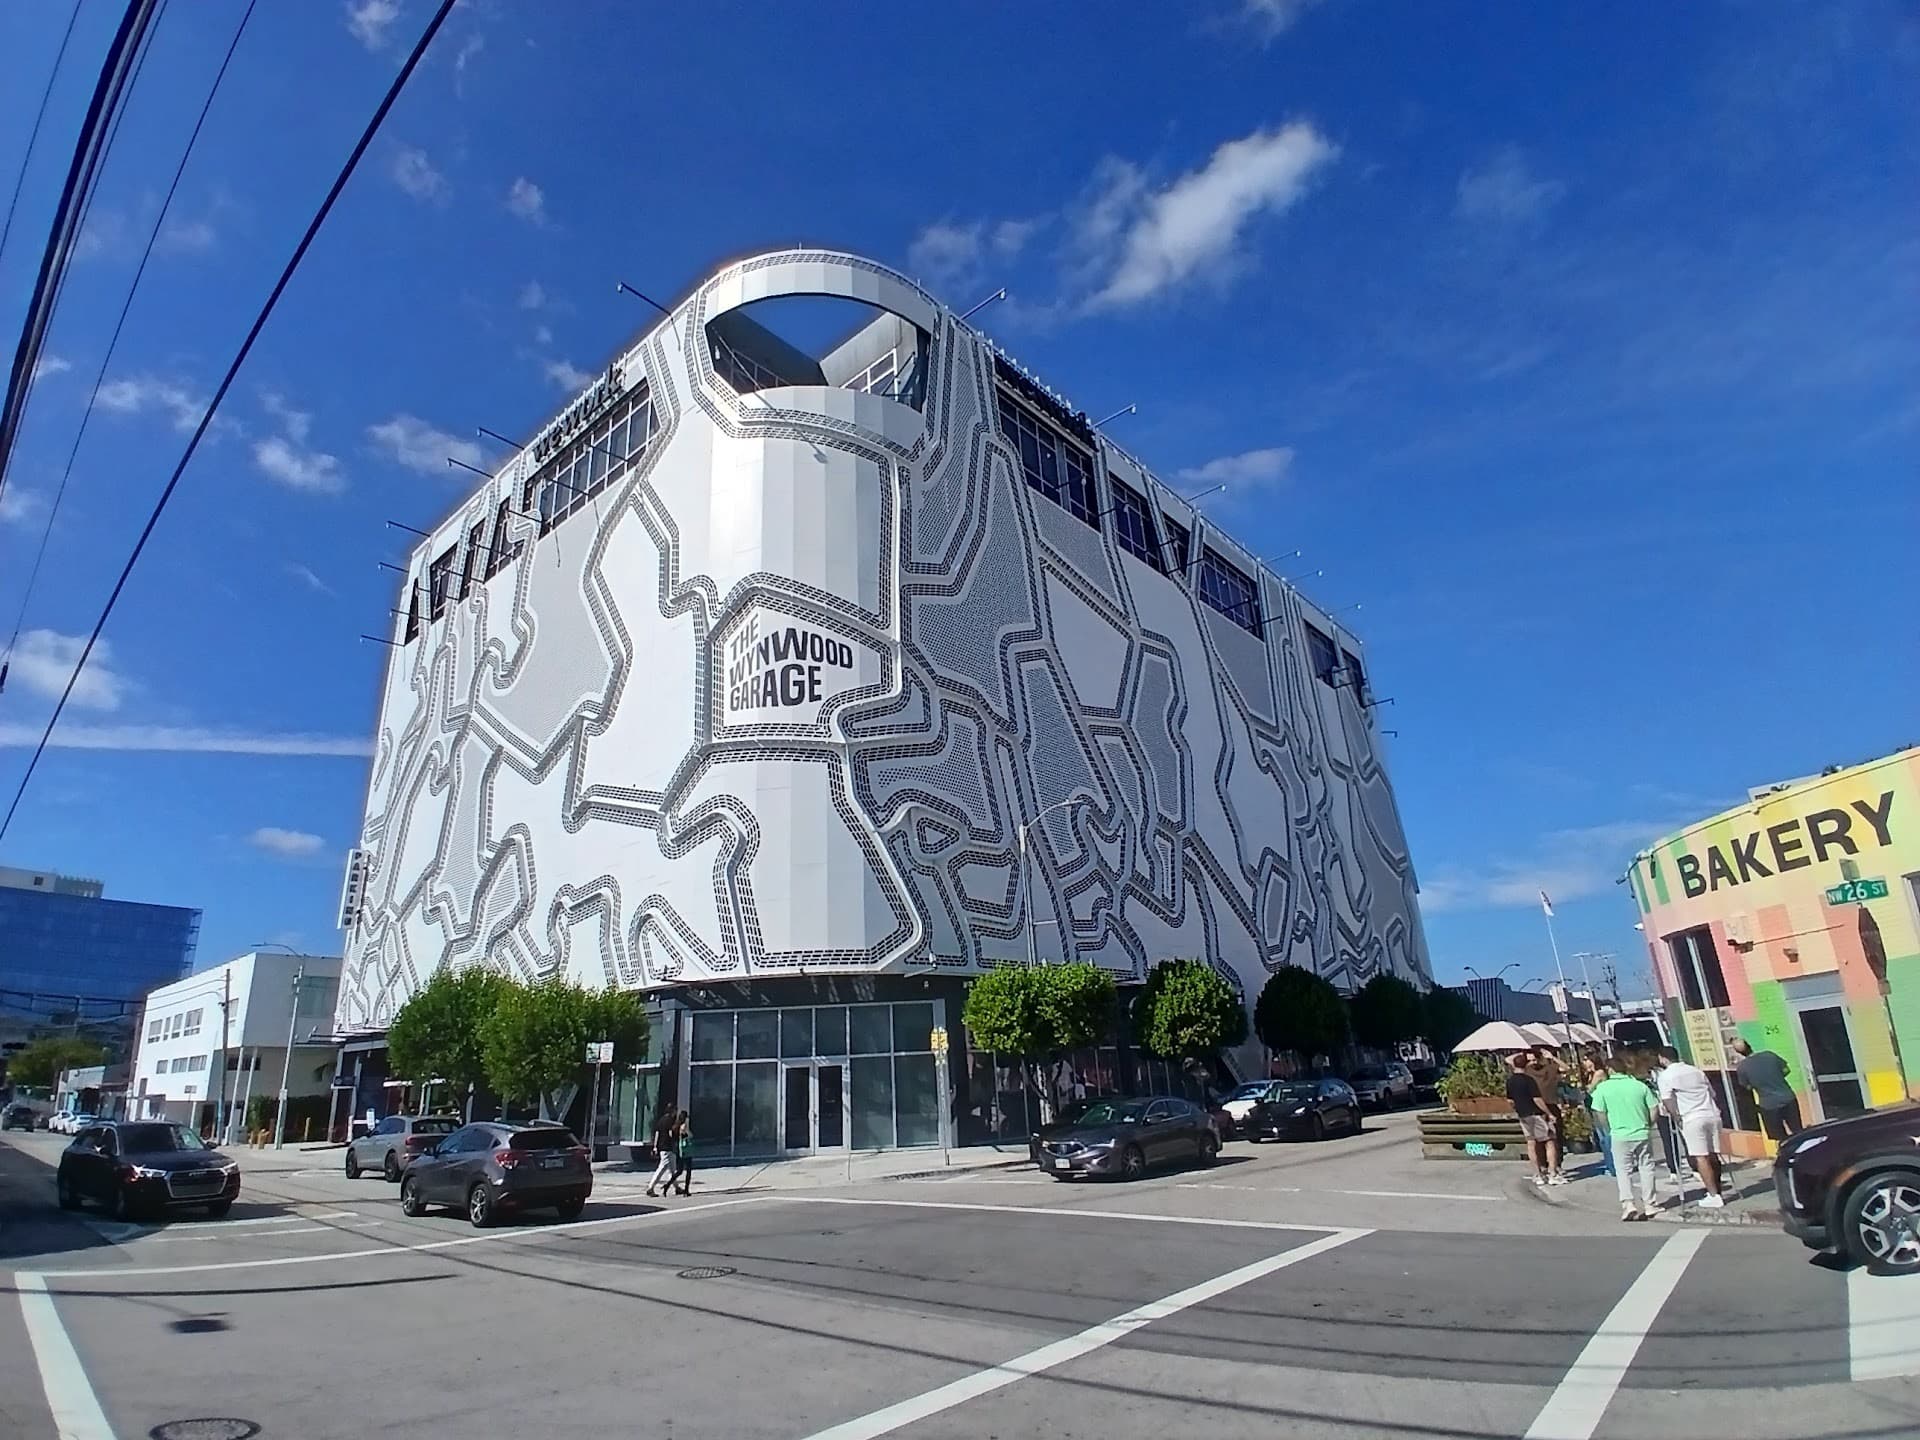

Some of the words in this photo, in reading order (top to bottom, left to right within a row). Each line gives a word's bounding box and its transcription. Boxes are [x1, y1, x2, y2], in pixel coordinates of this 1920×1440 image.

[729, 628, 853, 688] WYNWOOD
[730, 613, 759, 662] THE
[730, 664, 822, 711] GARAGE
[1677, 791, 1895, 899] BAKERY
[344, 851, 362, 926] PARKING
[1826, 889, 1843, 903] NW
[1844, 882, 1868, 901] 26
[1871, 882, 1886, 895] ST
